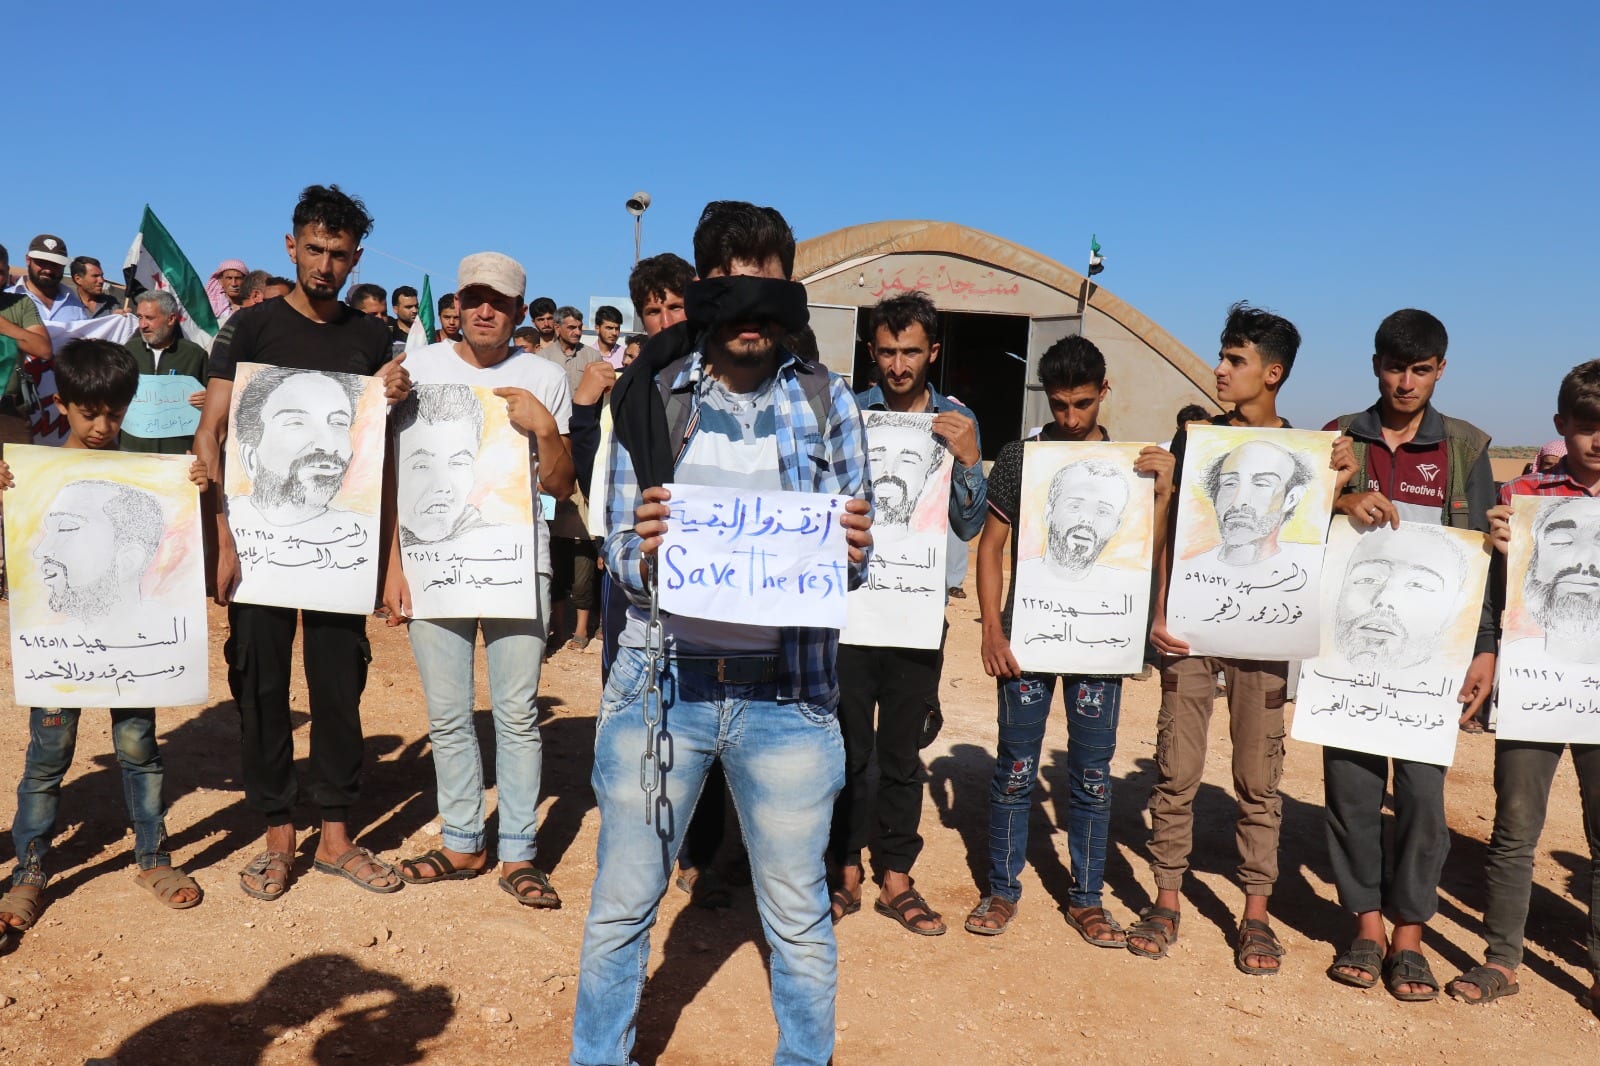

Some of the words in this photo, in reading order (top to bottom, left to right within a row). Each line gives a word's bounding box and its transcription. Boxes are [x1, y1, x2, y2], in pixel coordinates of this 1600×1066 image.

[745, 496, 838, 546] أنقذوا
[282, 522, 368, 549] الشهيد
[446, 543, 523, 568] الشهيد
[868, 547, 936, 568] الشهي
[465, 574, 523, 589] سعيد
[664, 544, 740, 590] Save
[797, 559, 847, 599] rest
[1234, 562, 1308, 595] الشهيد
[893, 576, 936, 597] جمعة
[1053, 593, 1132, 617] الشهيد
[1263, 602, 1303, 624] فواز
[73, 616, 187, 654] الشهيد
[1024, 621, 1072, 645] الغجر
[1075, 635, 1131, 648] رجب
[115, 664, 186, 696] وسيم
[1382, 677, 1453, 698] الشهيد
